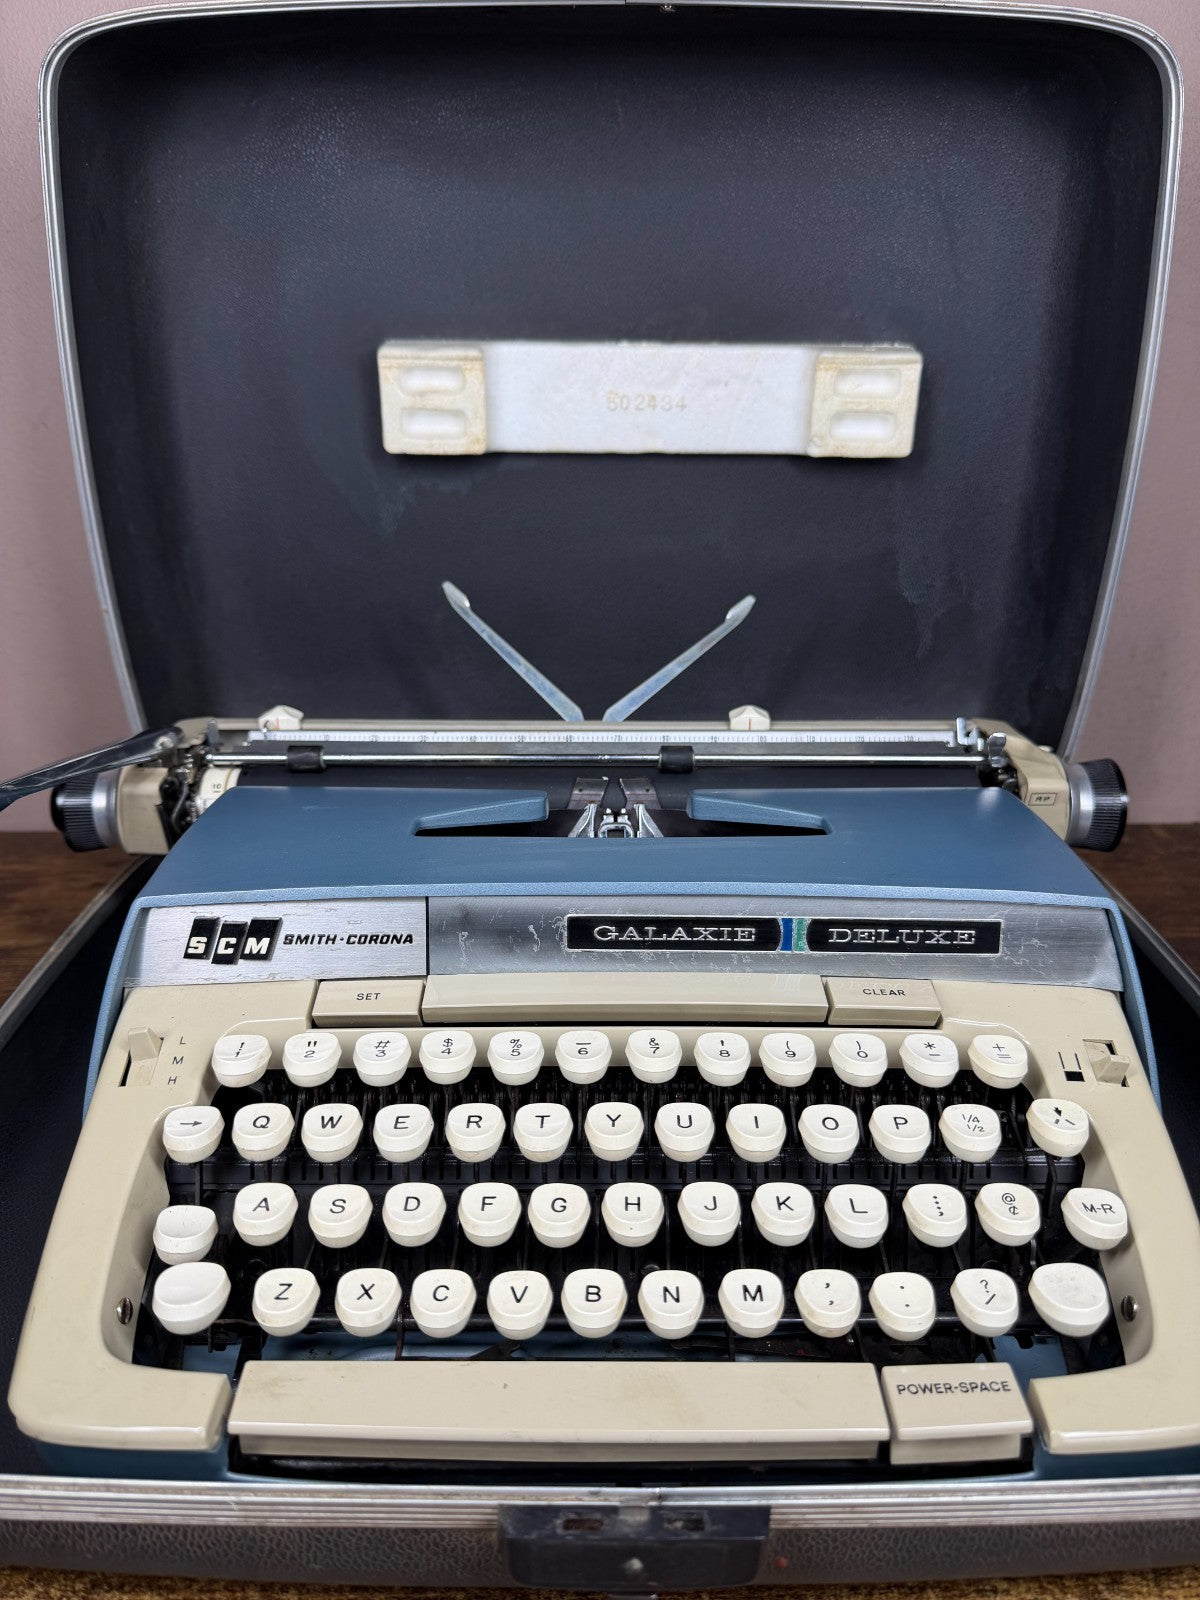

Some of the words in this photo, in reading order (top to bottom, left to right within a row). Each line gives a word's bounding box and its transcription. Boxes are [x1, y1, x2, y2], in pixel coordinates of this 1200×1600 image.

[593, 926, 756, 942] GALAXIE
[828, 928, 976, 945] DELUXE
[187, 936, 271, 955] SCM
[356, 992, 381, 1001] SET
[862, 988, 906, 996] CLEAR
[179, 1036, 187, 1045] L
[374, 1039, 391, 1050] #
[442, 1037, 454, 1048] $
[509, 1038, 523, 1049] %
[648, 1037, 660, 1047] &
[992, 1043, 1005, 1052] +
[303, 1050, 316, 1058] 2
[375, 1049, 387, 1058] 3
[440, 1047, 452, 1055] 4
[510, 1048, 521, 1057] 5
[577, 1047, 589, 1055] 6
[649, 1046, 660, 1055] 7
[718, 1049, 731, 1058] 8
[784, 1048, 797, 1058] 9
[856, 1050, 869, 1059] 0
[172, 1056, 184, 1065] M
[167, 1075, 178, 1085] H
[252, 1115, 271, 1129] Q
[320, 1114, 343, 1130] W
[393, 1115, 411, 1130] E
[465, 1114, 483, 1129] R
[534, 1114, 551, 1129] T
[605, 1114, 622, 1128] Y
[676, 1114, 693, 1129] U
[753, 1115, 760, 1129] I
[821, 1116, 840, 1131] O
[893, 1116, 909, 1130] P
[252, 1197, 270, 1212] A
[329, 1198, 347, 1214] S
[403, 1196, 421, 1212] D
[480, 1195, 497, 1212] F
[550, 1197, 567, 1213] G
[624, 1196, 641, 1212] H
[703, 1195, 718, 1211] J
[775, 1195, 794, 1212] K
[849, 1197, 869, 1214] L
[1001, 1192, 1016, 1206] @
[1081, 1202, 1115, 1214] M-R
[273, 1283, 293, 1301] Z
[356, 1283, 375, 1301] X
[432, 1284, 450, 1302] C
[742, 1284, 764, 1302] M
[979, 1279, 990, 1293] ?
[510, 1285, 529, 1304] V
[585, 1284, 602, 1303] B
[662, 1285, 681, 1304] N
[896, 1381, 1012, 1395] POWER-SPACE
